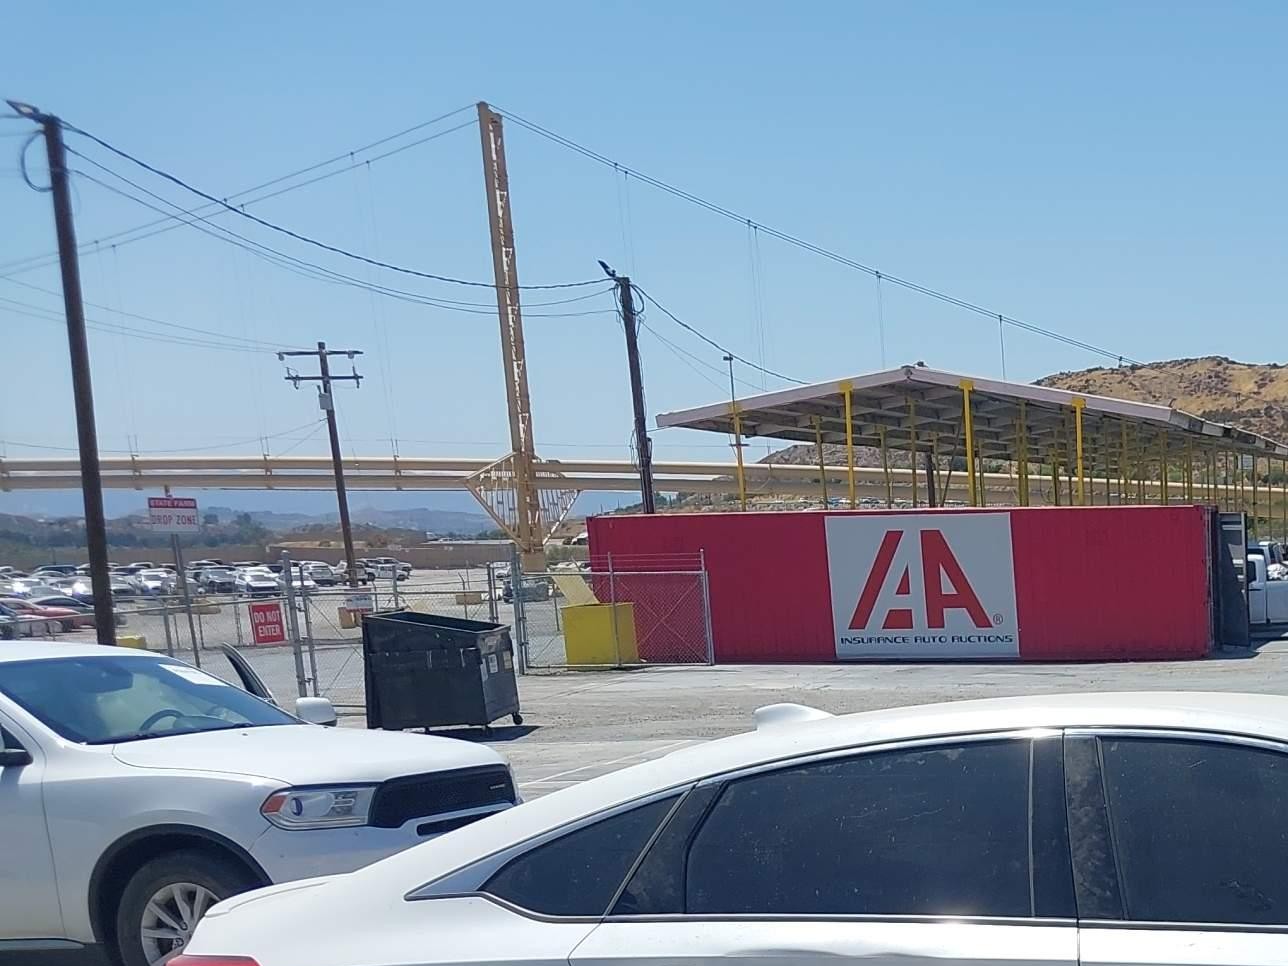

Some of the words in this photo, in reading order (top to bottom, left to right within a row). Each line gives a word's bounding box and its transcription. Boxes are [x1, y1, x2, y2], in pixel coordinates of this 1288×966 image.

[151, 514, 173, 525] DROP
[176, 514, 197, 525] ZONE
[253, 611, 265, 623] DO
[266, 610, 281, 623] NOT
[258, 624, 282, 637] ENTER
[840, 635, 911, 646] INSURANCE
[914, 635, 948, 644] AUTO
[951, 634, 1014, 644] AUCTIONS
